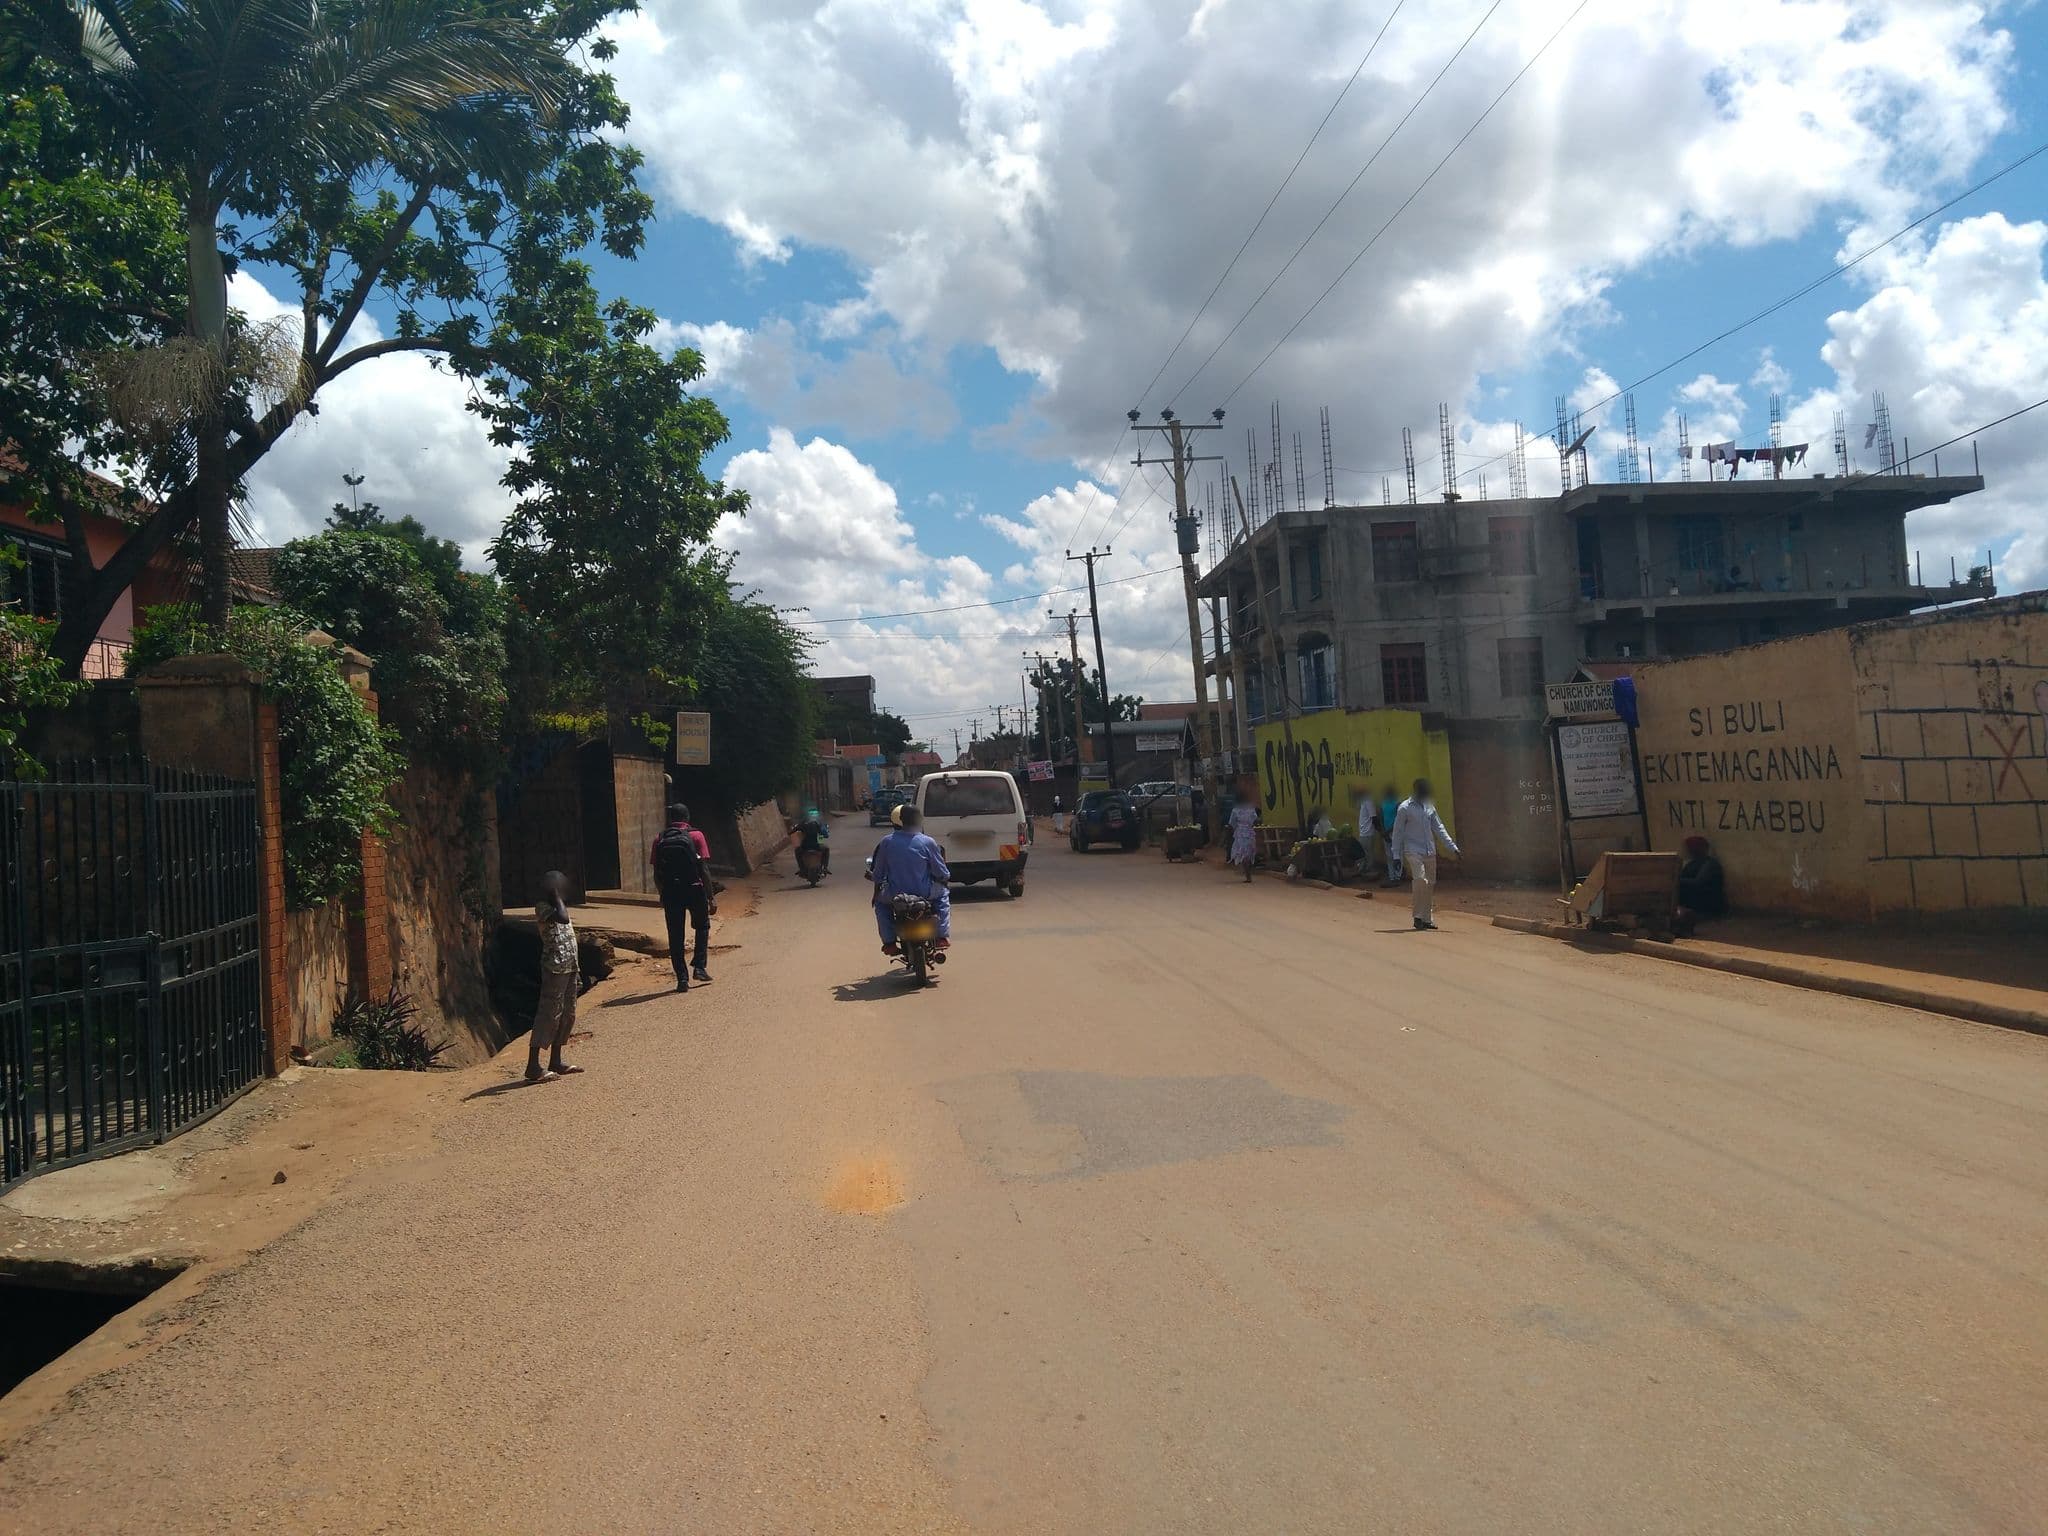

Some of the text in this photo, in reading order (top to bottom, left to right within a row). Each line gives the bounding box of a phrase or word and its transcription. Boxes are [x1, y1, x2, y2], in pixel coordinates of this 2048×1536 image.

[1550, 685, 1583, 700] CHURCH
[1583, 685, 1594, 698] OF
[1563, 697, 1615, 713] NAMUWONGO
[1689, 700, 1785, 737] SI BULI
[1645, 744, 1843, 784] EKITEMAGANNA
[1669, 799, 1825, 833] NTI ZAABBU
